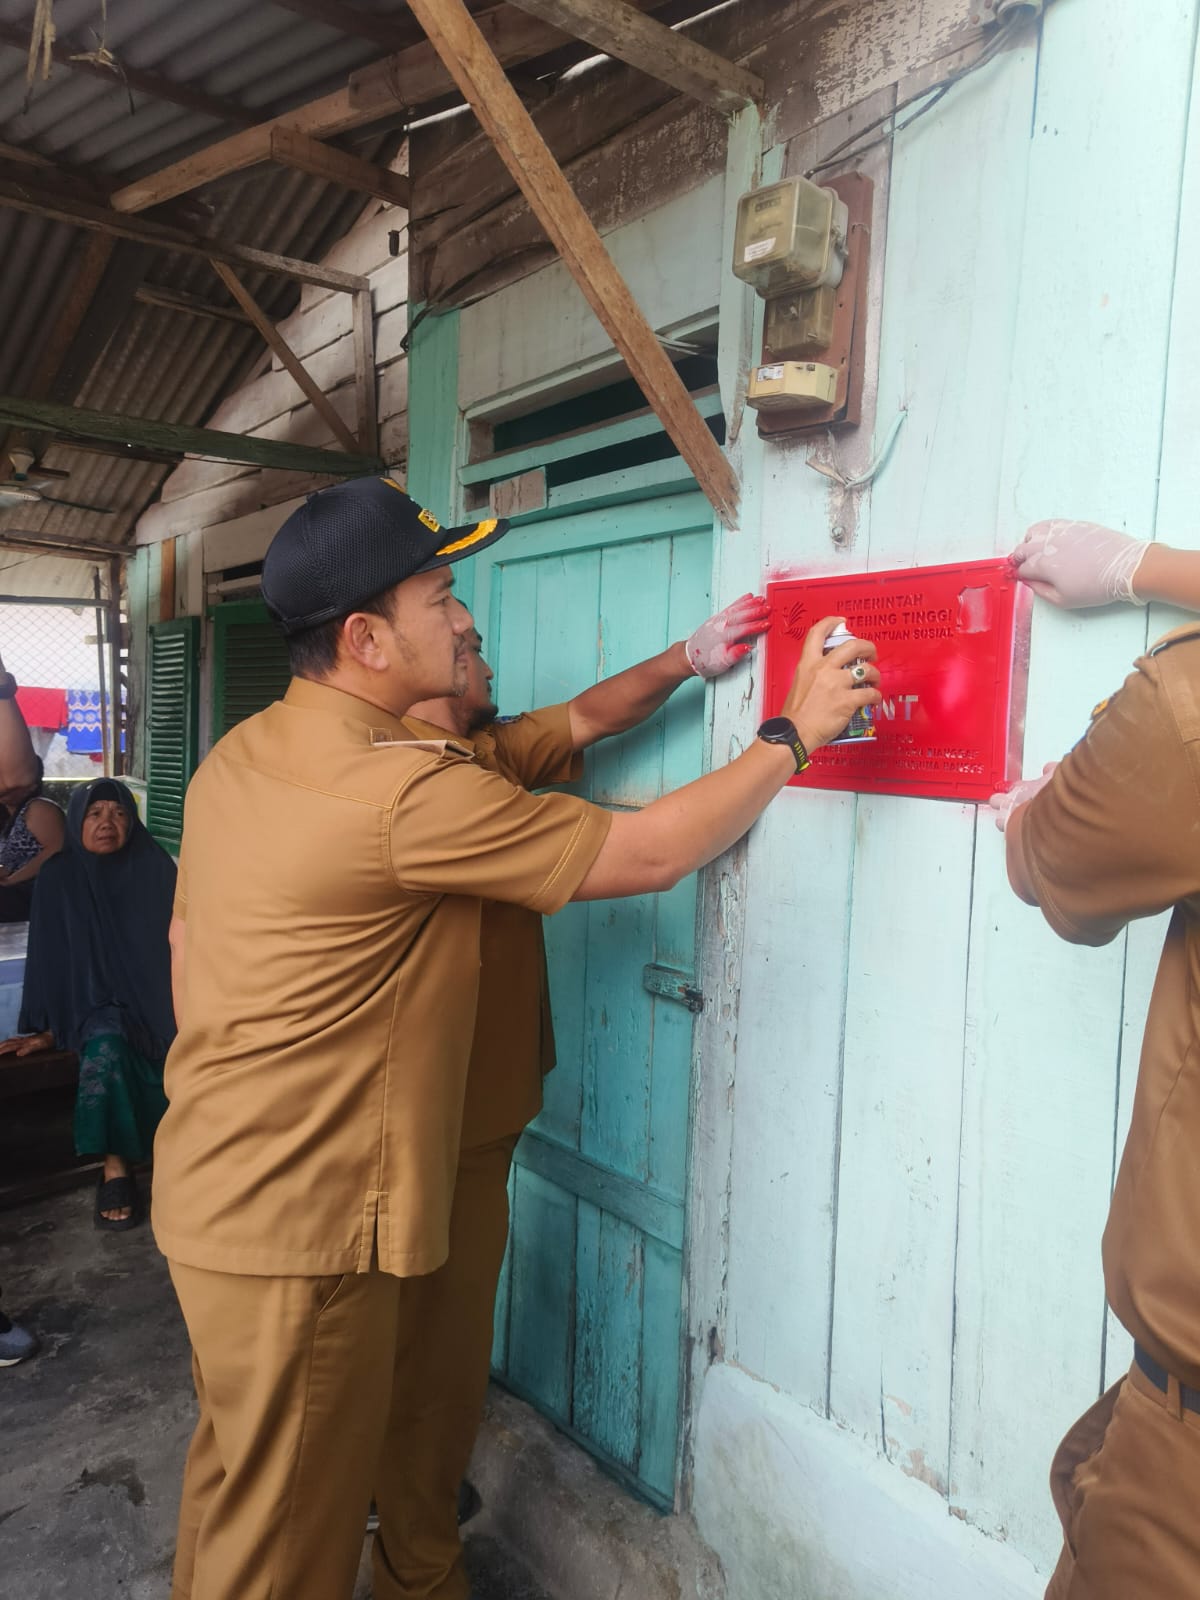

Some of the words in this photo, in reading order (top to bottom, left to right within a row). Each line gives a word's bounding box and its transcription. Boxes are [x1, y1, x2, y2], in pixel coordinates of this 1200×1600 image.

[837, 593, 923, 612] PEMERINTAH
[848, 613, 897, 628] TEBING
[902, 609, 952, 625] TINGGI
[913, 627, 954, 640] SOSIAL
